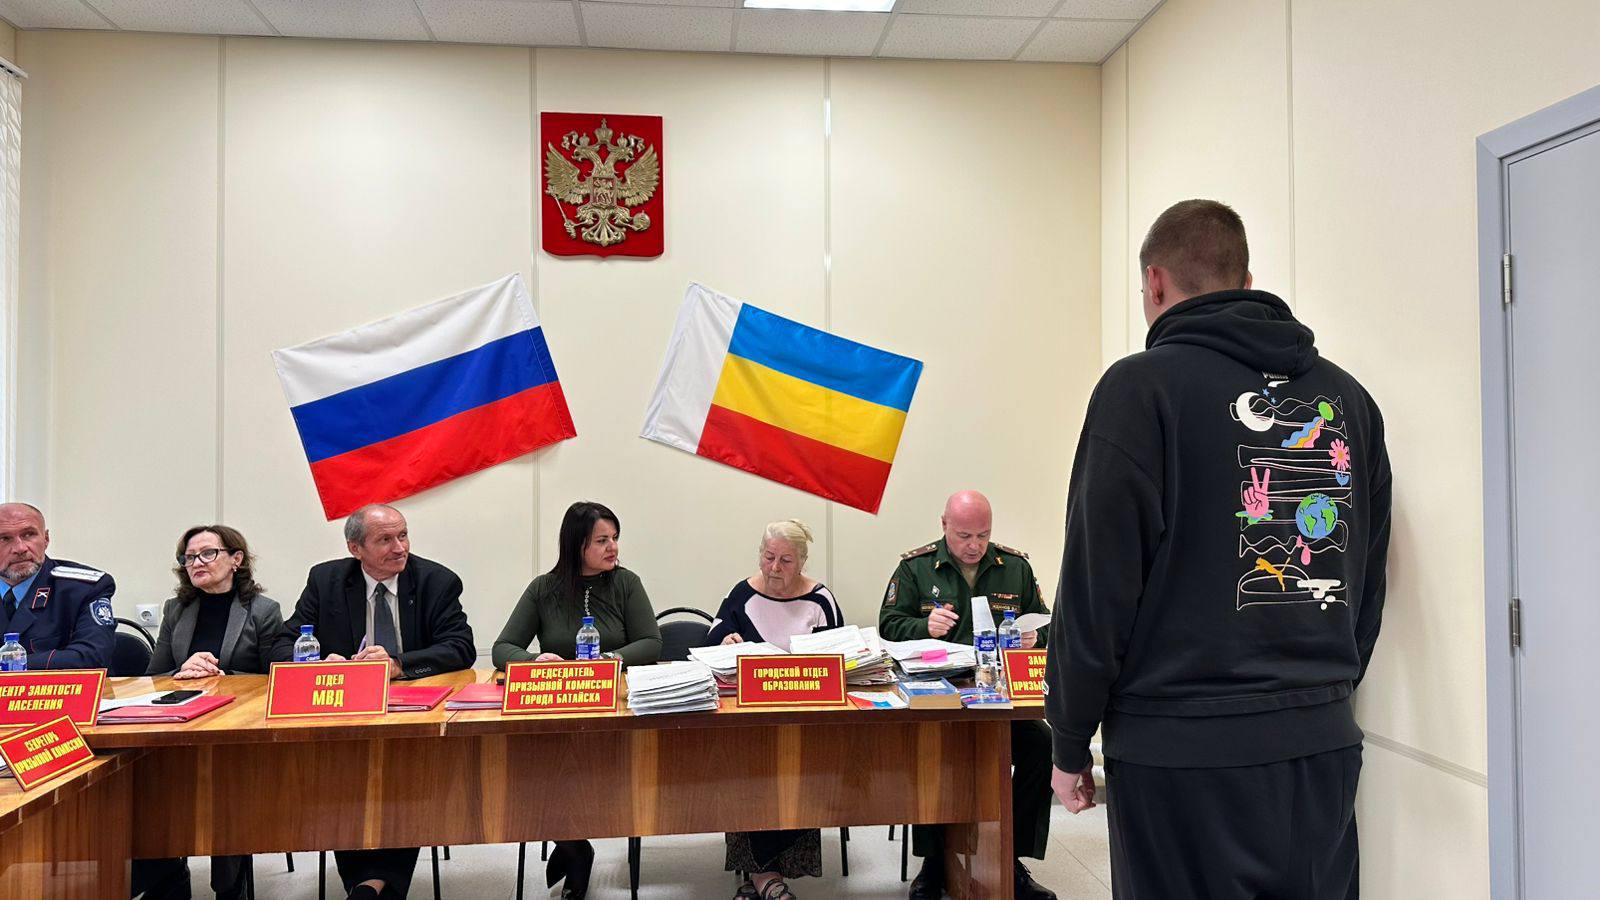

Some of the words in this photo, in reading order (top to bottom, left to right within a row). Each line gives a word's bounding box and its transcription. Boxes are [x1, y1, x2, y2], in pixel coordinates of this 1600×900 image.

[1028, 655, 1047, 666] ЗАМ
[530, 667, 595, 679] ПРЕДСЕДАТЕЛЬ
[753, 666, 801, 679] ГОРОДСКОЙ
[803, 667, 829, 679] ОТДЕЛ
[315, 674, 345, 687] ОТДЕЛ
[510, 680, 562, 693] ПРИЗЫВНОЙ
[565, 679, 613, 691] КОМИССИИ
[762, 680, 821, 691] ОБРАЗОВАНИЯ
[28, 684, 83, 697] ЗАНЯТОСТИ
[8, 699, 64, 711] НАСЕЛЕНИЯ
[312, 689, 345, 708] МВД
[520, 694, 553, 706] ГОРОДА
[556, 692, 600, 704] БАТАЙСКА
[24, 731, 60, 753] СЕКРЕТАРЬ
[14, 748, 54, 775] ПРИЗЫВНОЙ
[50, 736, 85, 759] КОМИССИИ
